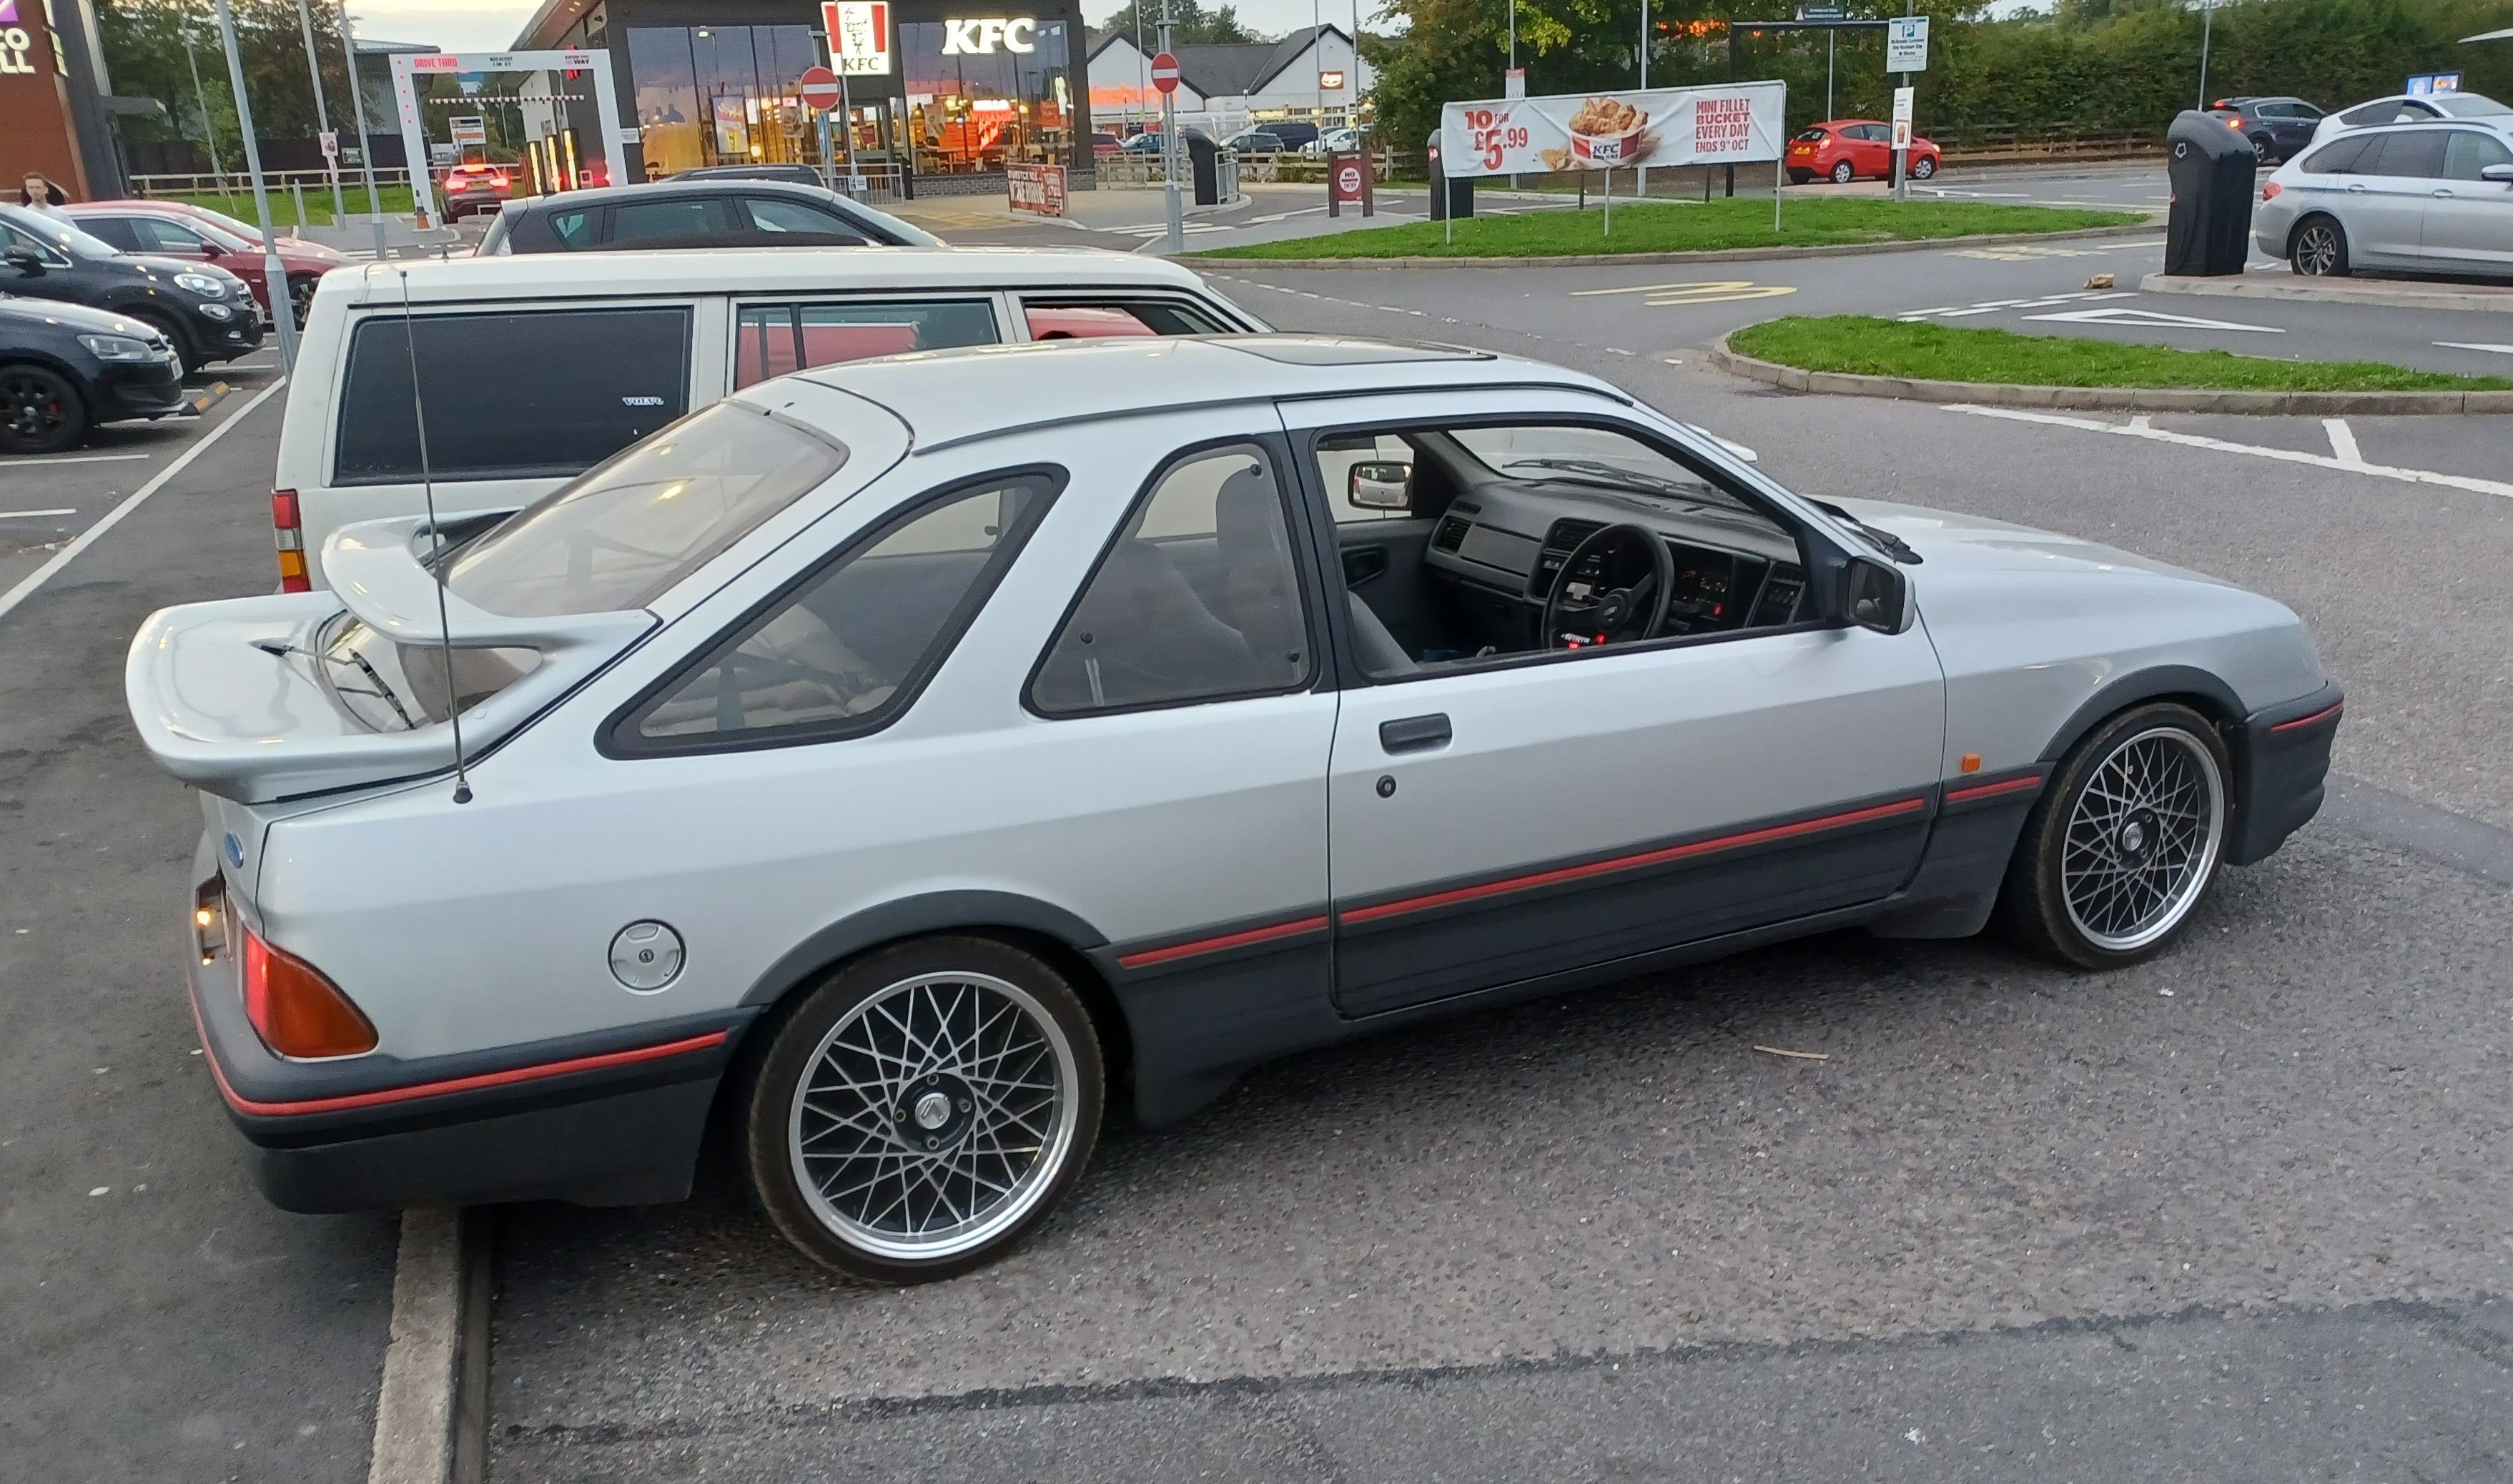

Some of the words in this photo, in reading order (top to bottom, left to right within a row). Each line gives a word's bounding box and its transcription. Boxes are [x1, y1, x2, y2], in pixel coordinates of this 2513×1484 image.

[941, 17, 1036, 55] KFC
[414, 57, 436, 69] DRIVE
[437, 57, 458, 67] THRU
[842, 57, 879, 71] KFC
[1696, 99, 1717, 114] MINI
[1719, 99, 1750, 113] FILLET
[1465, 110, 1493, 129] 10
[1494, 113, 1509, 124] FOR
[1696, 112, 1750, 124] BUCKET
[1696, 124, 1727, 139] EVERY
[1729, 123, 1749, 137] DAY
[1474, 127, 1528, 170] £5.99
[1592, 143, 1619, 154] KFC
[1695, 141, 1717, 153] ENDS
[1732, 139, 1749, 151] OCT
[622, 396, 664, 406] VOLVO
